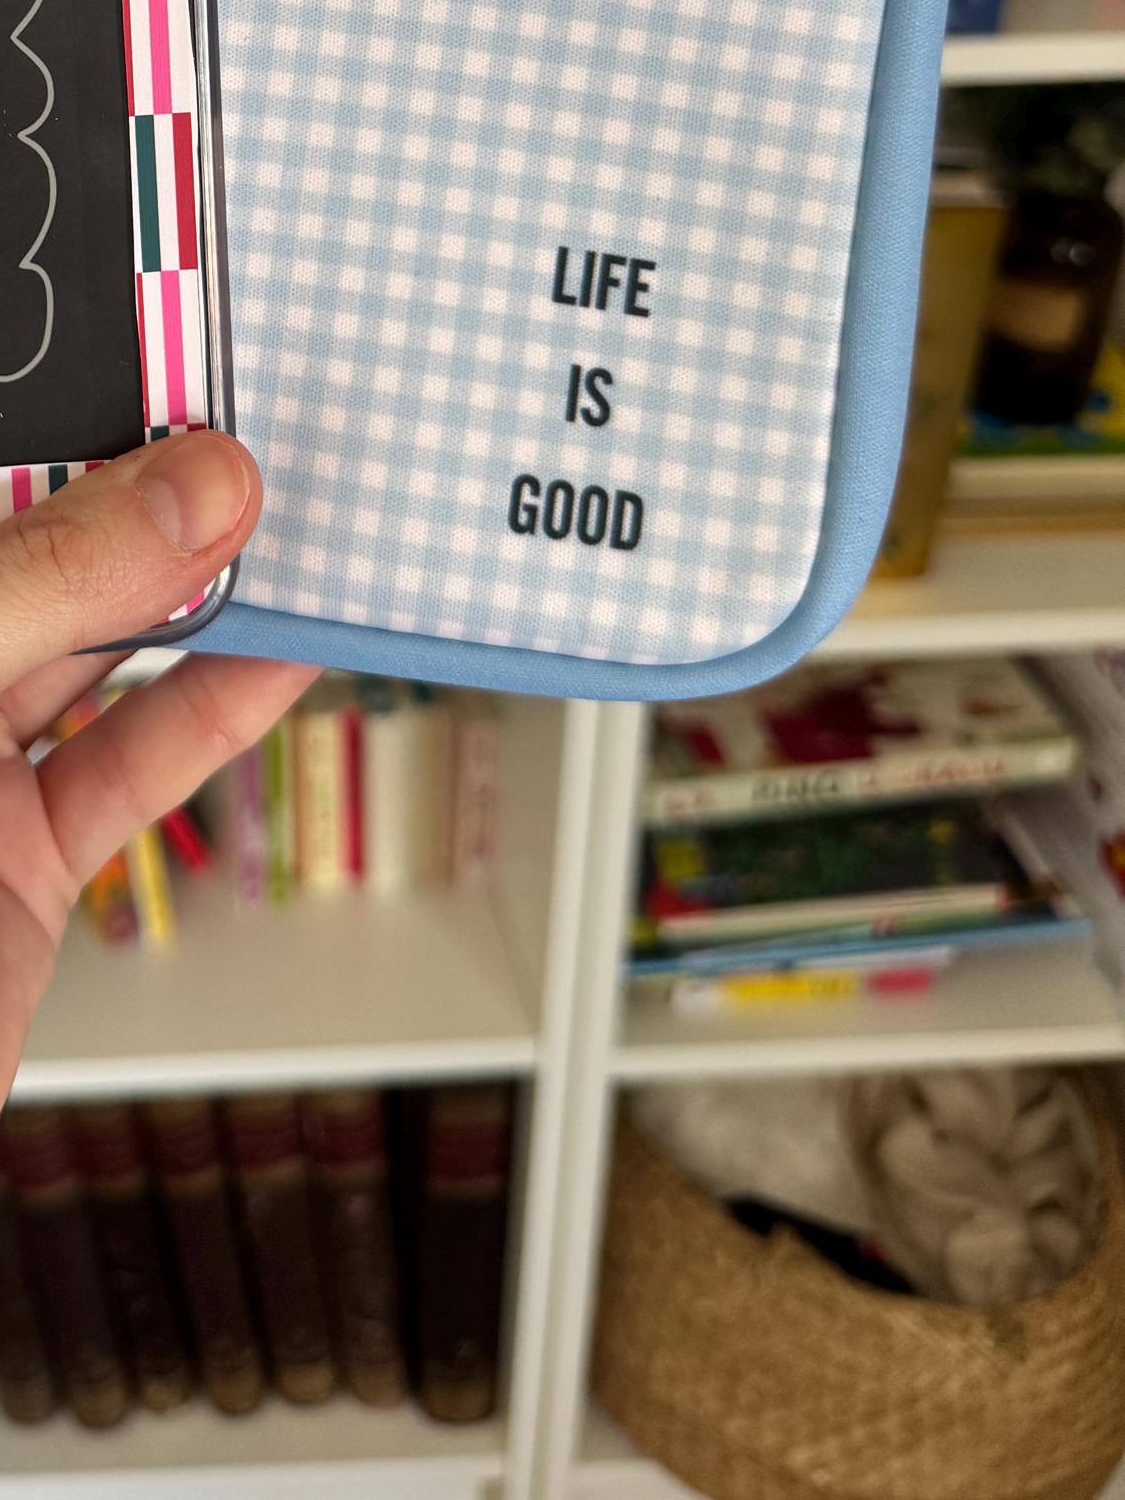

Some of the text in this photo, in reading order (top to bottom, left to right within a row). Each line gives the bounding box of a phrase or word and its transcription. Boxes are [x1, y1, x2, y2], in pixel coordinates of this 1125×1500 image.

[551, 246, 657, 318] LIFE
[565, 363, 614, 428] IS
[507, 473, 645, 551] GOOD
